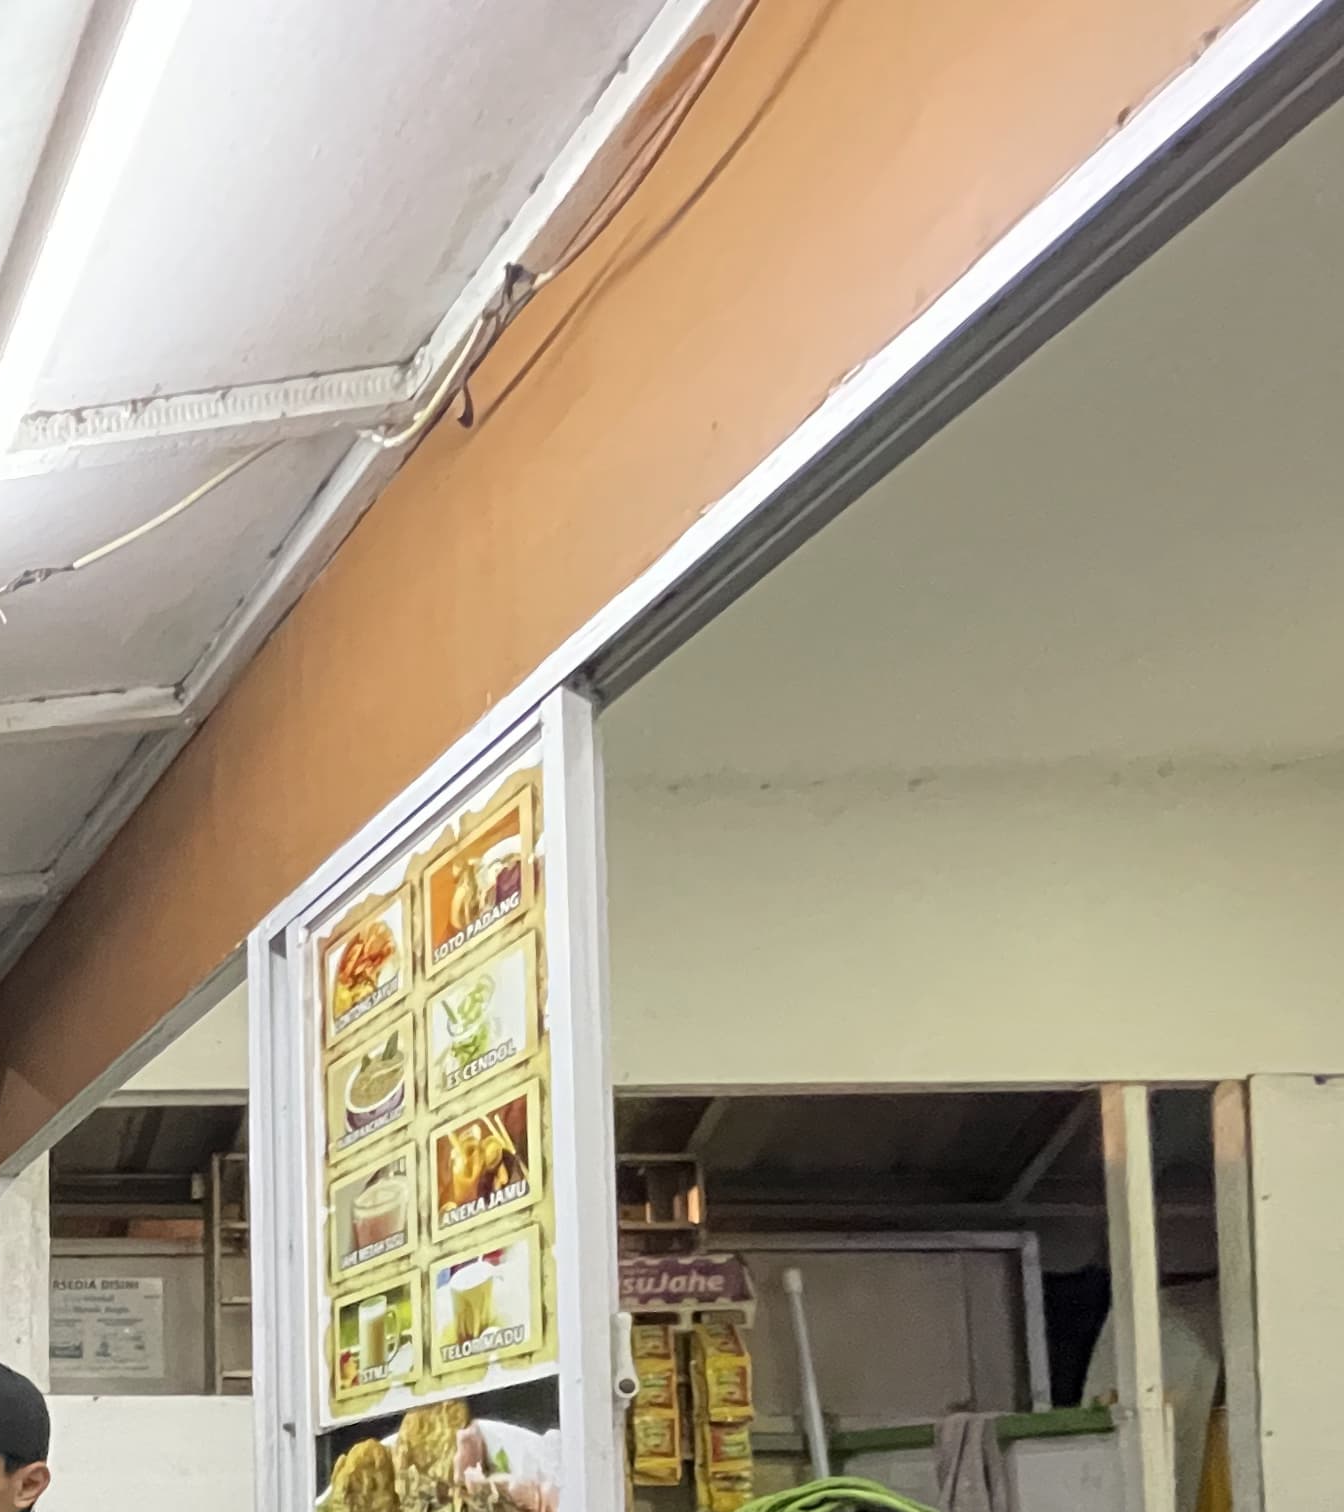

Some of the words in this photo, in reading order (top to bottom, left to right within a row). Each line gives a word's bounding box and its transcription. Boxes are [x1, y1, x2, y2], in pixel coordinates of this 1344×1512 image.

[434, 932, 465, 962] SOTO
[465, 891, 520, 941] PADANG
[446, 1069, 463, 1090] ES
[463, 1038, 517, 1081] CENDOL
[440, 1196, 485, 1228] ANEKA
[487, 1179, 528, 1209] JAMU
[483, 1324, 526, 1350] MADU
